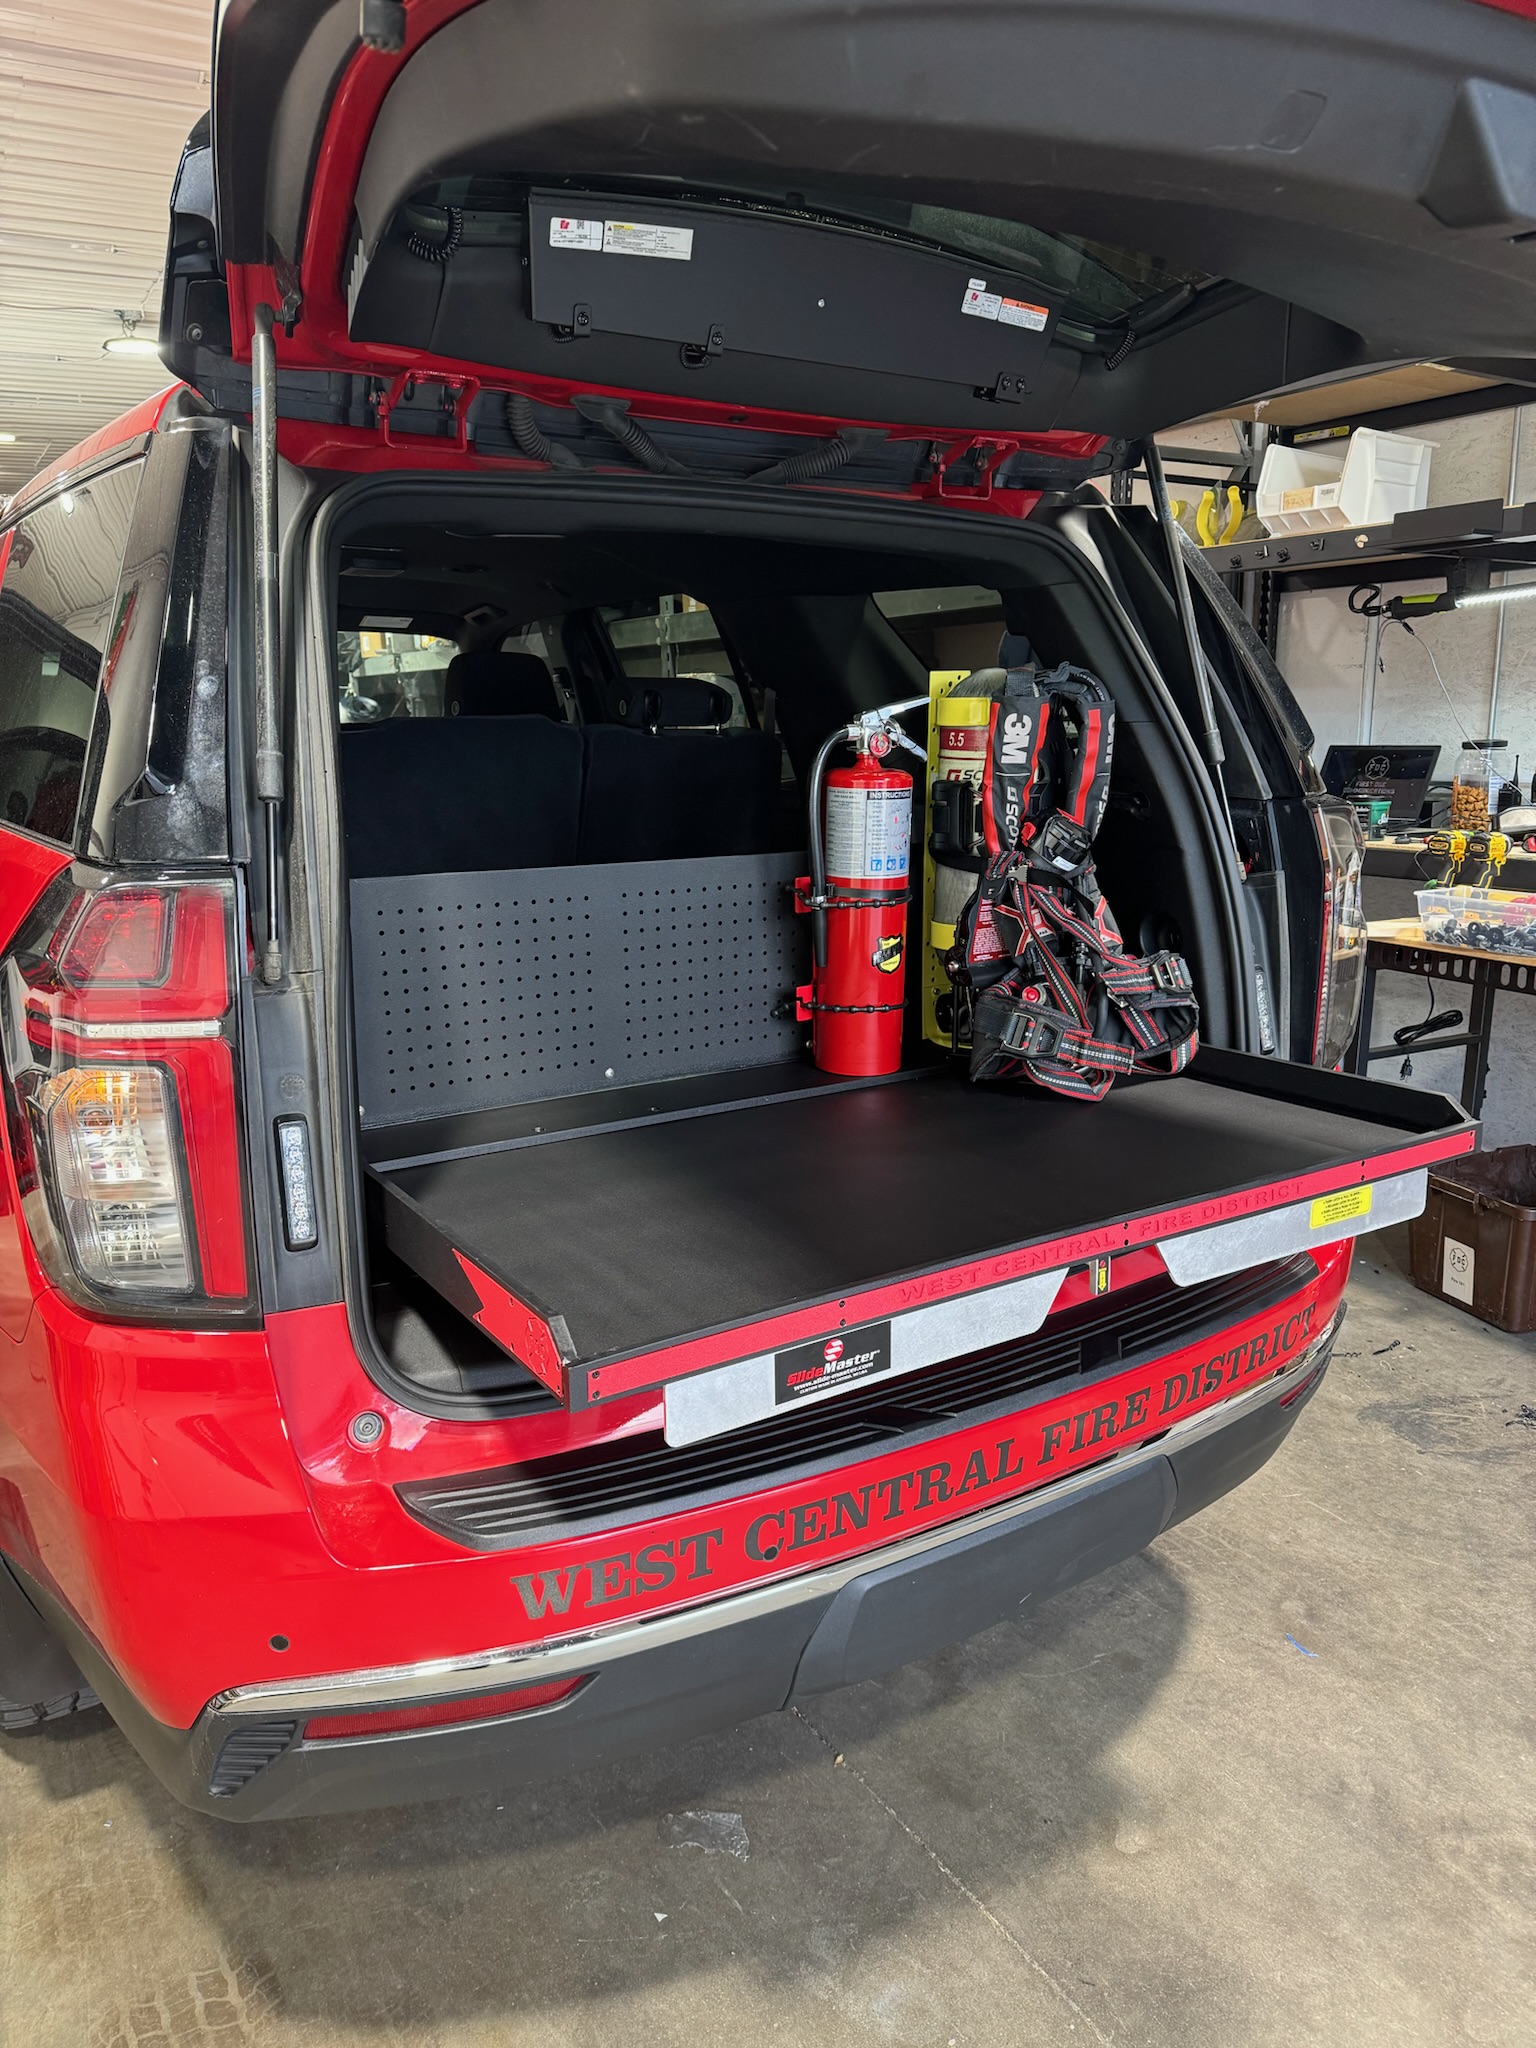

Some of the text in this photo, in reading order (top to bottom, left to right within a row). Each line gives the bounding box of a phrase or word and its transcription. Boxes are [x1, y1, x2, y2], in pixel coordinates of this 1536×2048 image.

[948, 732, 965, 747] 5.5
[1000, 712, 1033, 765] 3M
[111, 1024, 200, 1037] CHEVROLET
[900, 1181, 1304, 1304] WEST CENTRAL FIRE DISTRICT
[793, 1361, 874, 1392] www.slide-master.com
[509, 1302, 1317, 1621] WEST CENTRAL FIRE DISTRICT
